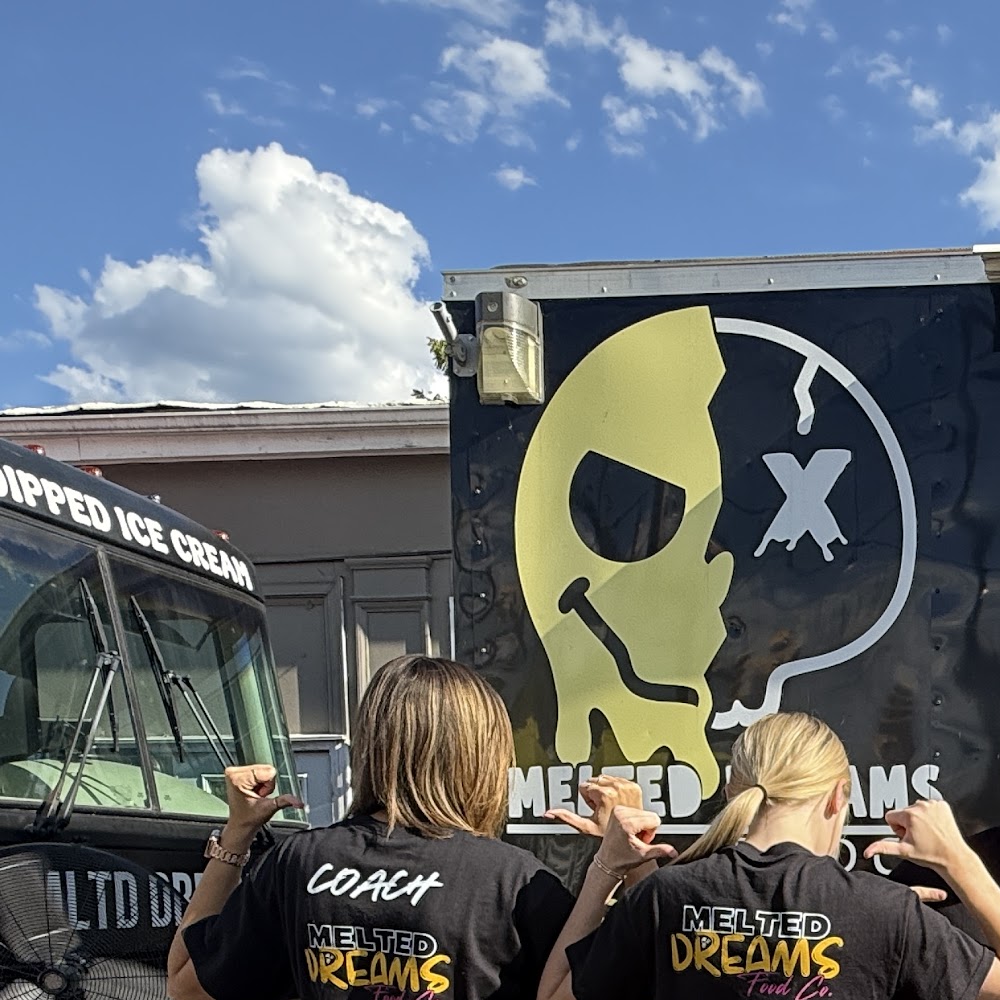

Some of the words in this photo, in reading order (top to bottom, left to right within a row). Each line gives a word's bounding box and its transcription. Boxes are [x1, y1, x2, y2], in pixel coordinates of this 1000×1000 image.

[114, 506, 170, 555] ICE
[170, 529, 253, 591] CREAM
[307, 863, 444, 906] COACH
[307, 923, 438, 958] MELTED
[682, 905, 831, 940] MELTED
[304, 947, 451, 994] DREAMS
[670, 932, 844, 980] DREAMS
[737, 971, 791, 999] Food
